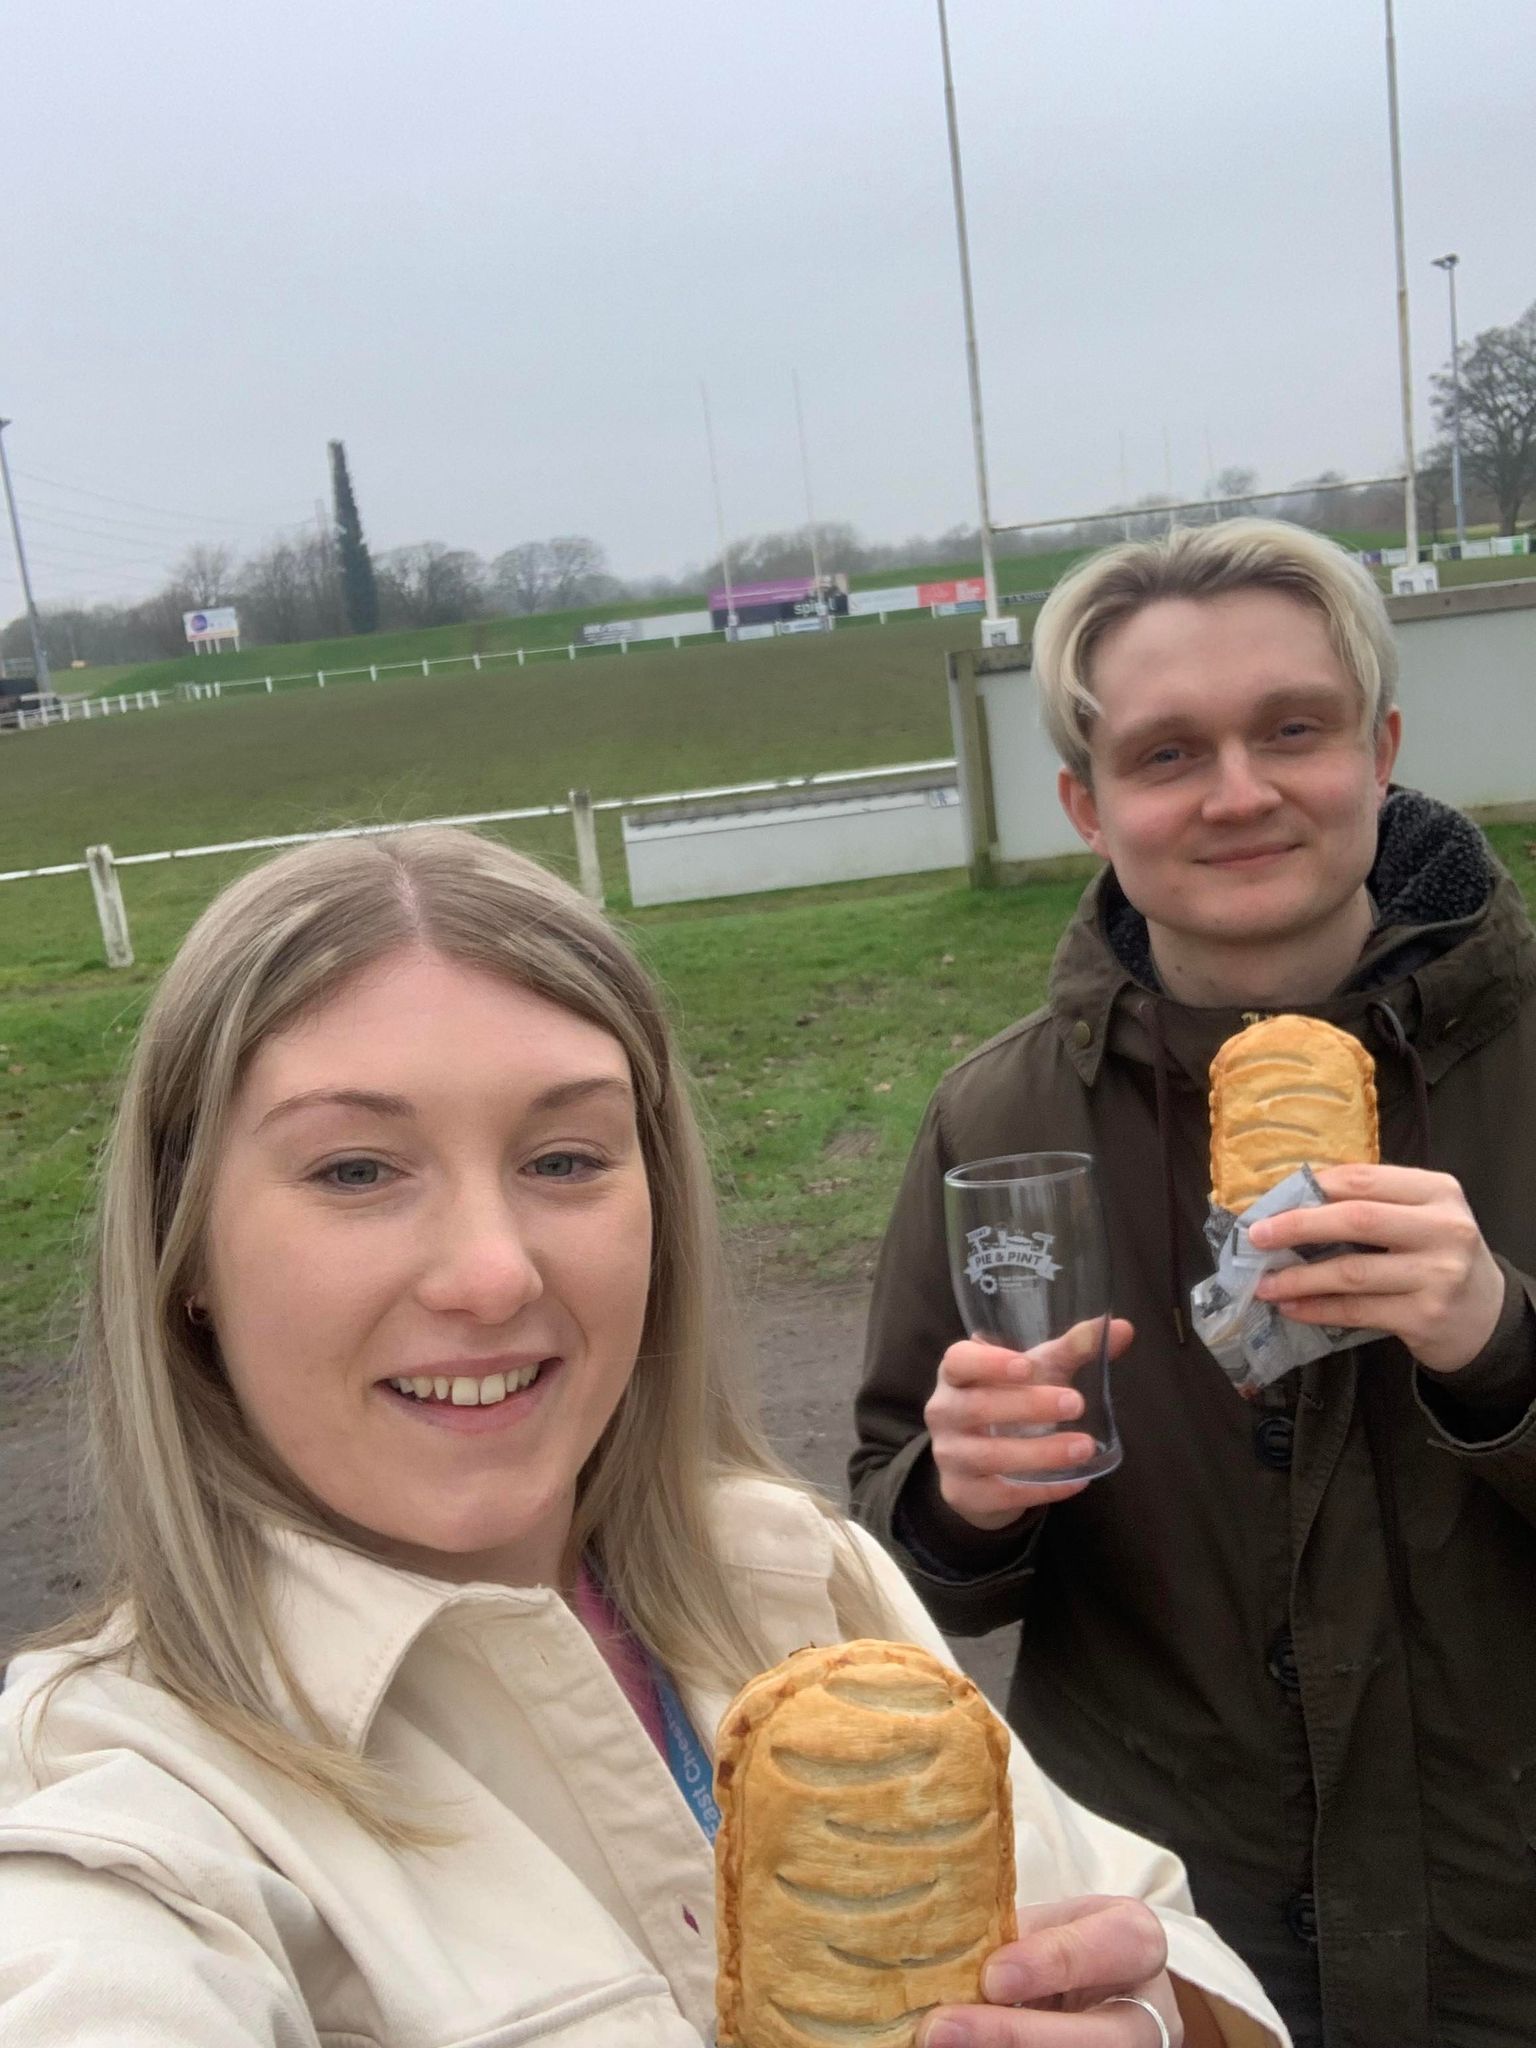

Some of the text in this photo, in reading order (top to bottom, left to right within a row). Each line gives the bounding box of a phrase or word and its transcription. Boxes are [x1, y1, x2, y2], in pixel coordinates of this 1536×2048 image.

[975, 1252, 1042, 1267] PIE & PINT
[693, 1784, 718, 1837] East
